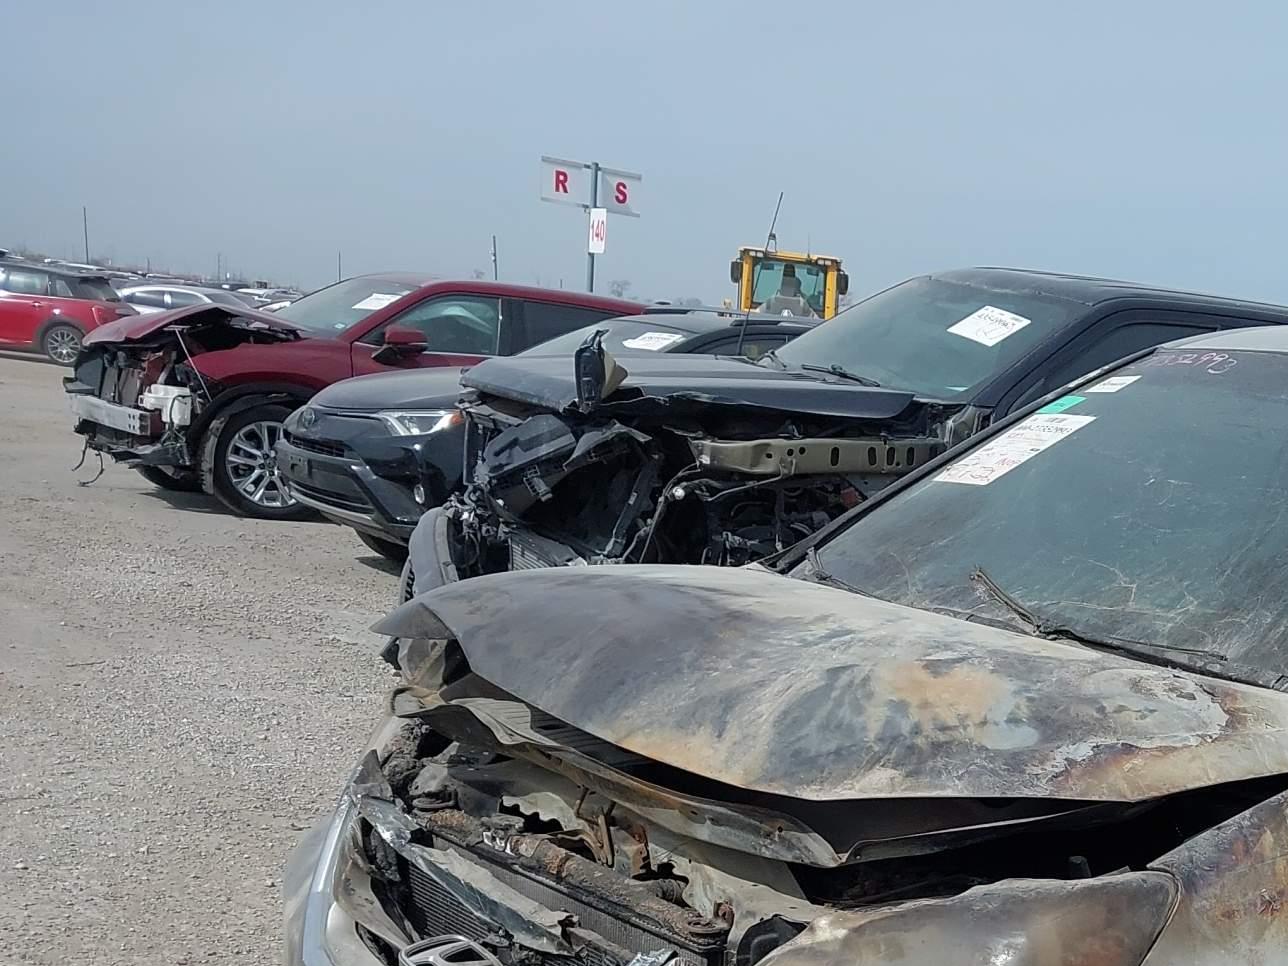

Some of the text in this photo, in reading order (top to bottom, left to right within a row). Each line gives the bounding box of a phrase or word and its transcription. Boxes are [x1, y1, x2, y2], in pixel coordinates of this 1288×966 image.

[555, 170, 568, 193] R
[615, 182, 628, 204] S
[591, 219, 604, 241] 140
